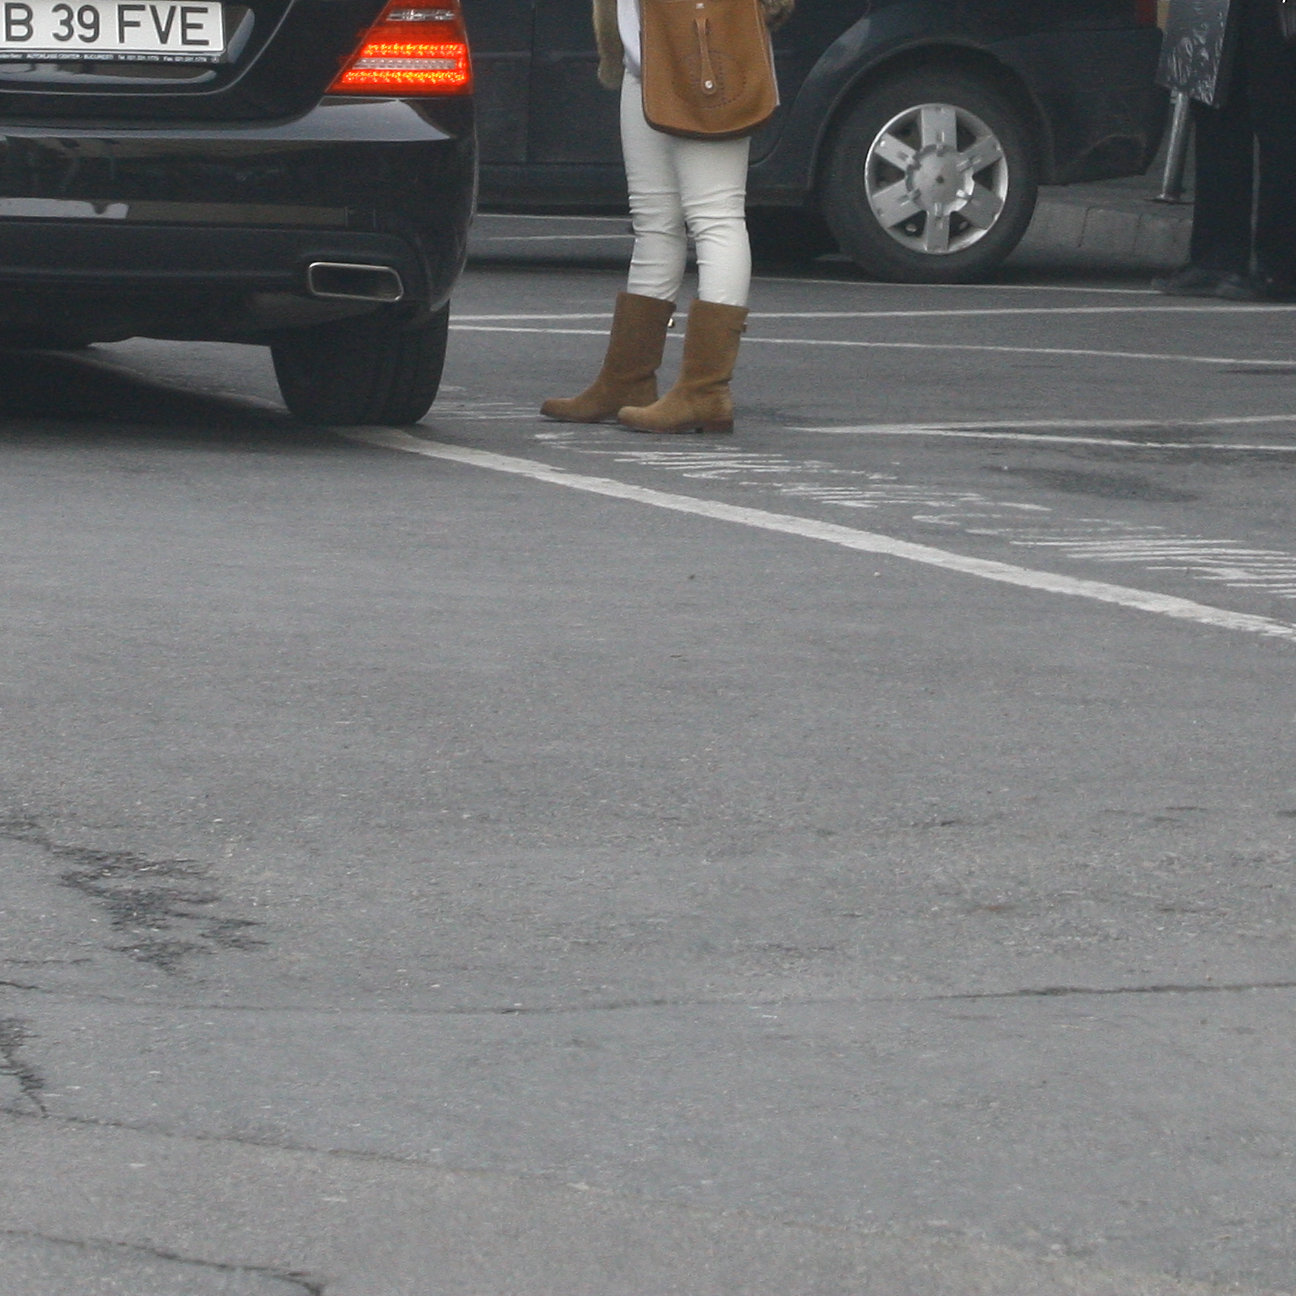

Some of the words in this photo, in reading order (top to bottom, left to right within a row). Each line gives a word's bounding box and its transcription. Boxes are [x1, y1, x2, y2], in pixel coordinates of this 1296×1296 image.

[4, 3, 34, 42] B
[52, 3, 100, 43] 39
[116, 4, 210, 46] FVE
